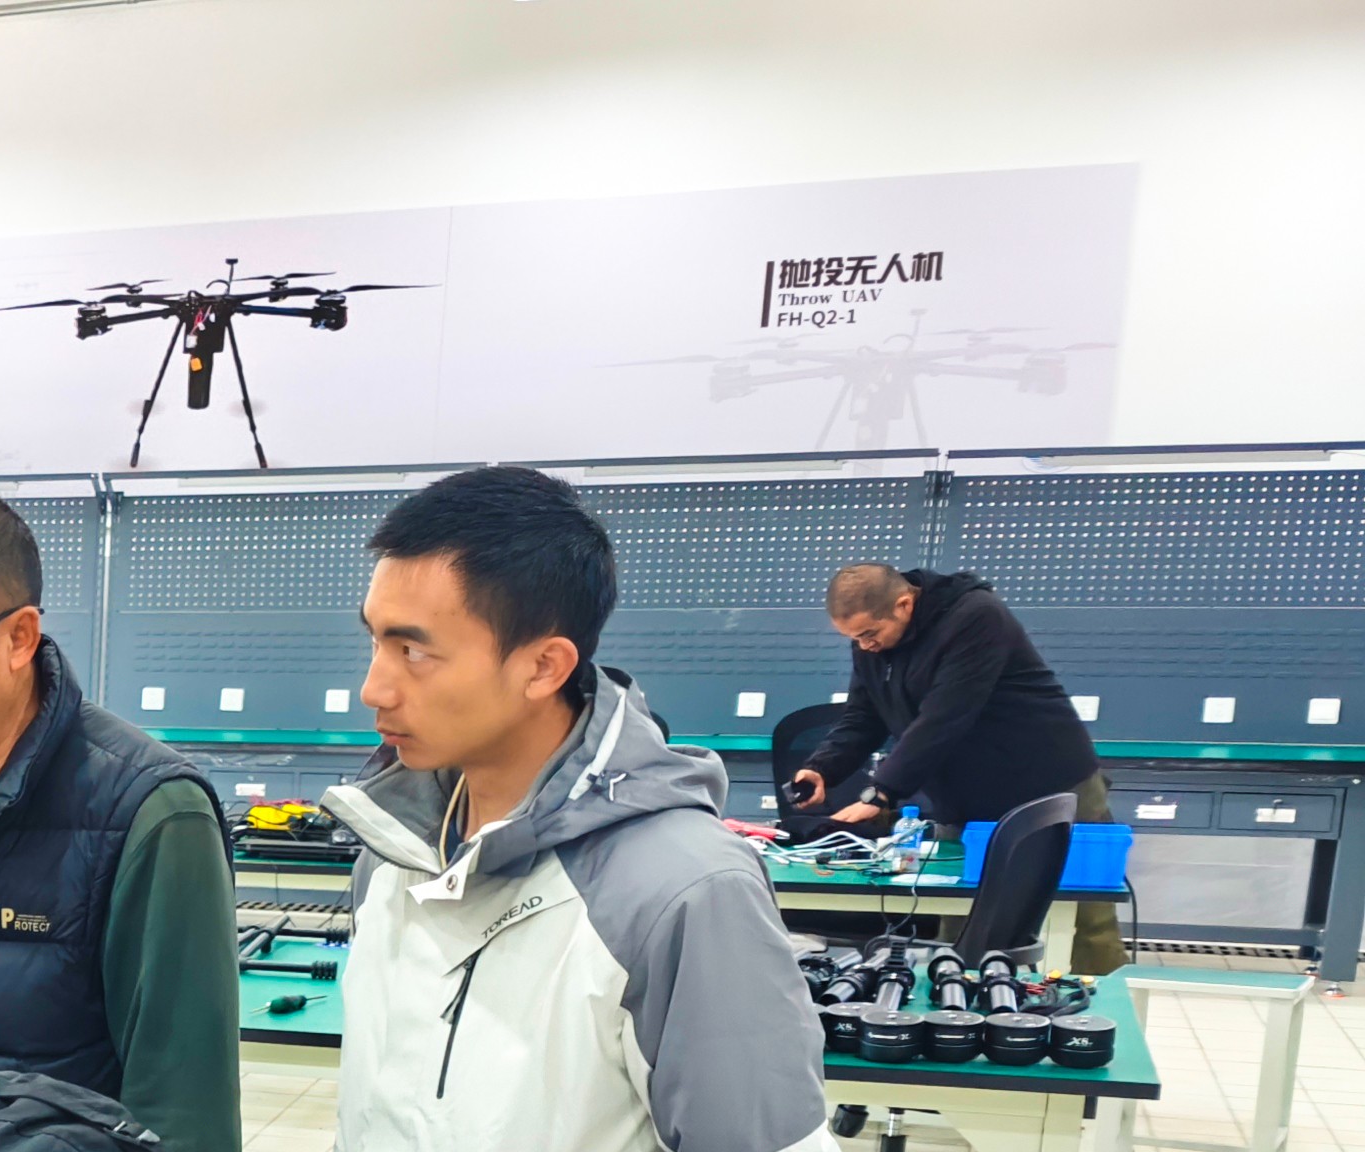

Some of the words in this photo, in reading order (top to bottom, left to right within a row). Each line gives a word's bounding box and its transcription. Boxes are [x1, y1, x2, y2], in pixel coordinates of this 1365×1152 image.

[778, 251, 944, 289] 抛投无人机
[778, 292, 833, 307] Throw
[842, 287, 883, 303] UAV
[777, 308, 857, 328] FH-Q2-1
[481, 895, 544, 939] TOREAD
